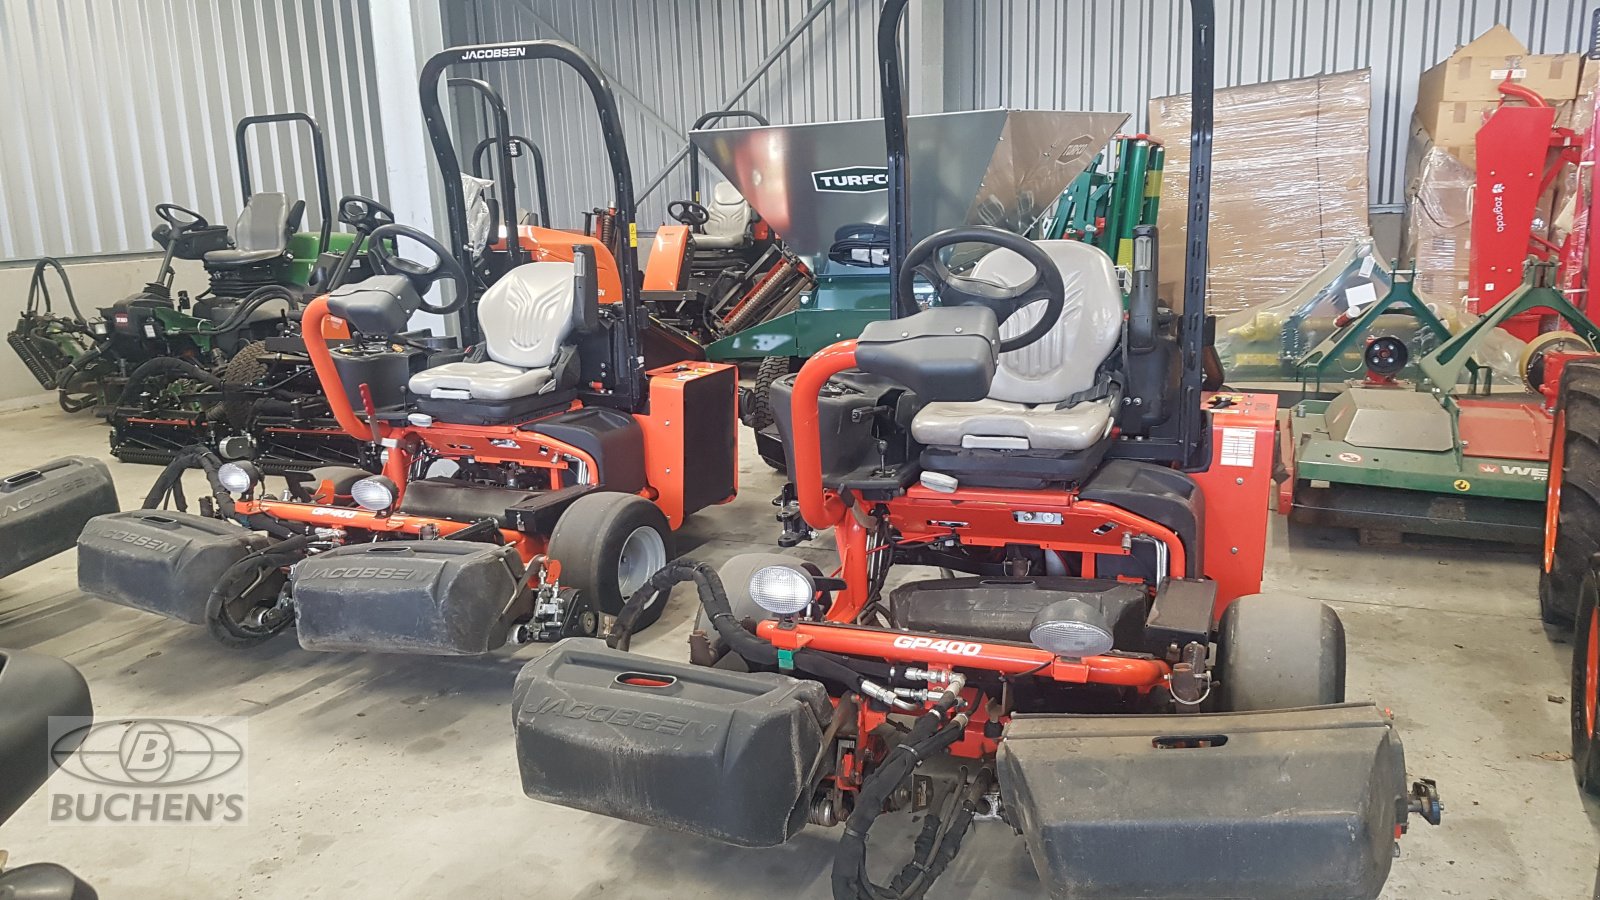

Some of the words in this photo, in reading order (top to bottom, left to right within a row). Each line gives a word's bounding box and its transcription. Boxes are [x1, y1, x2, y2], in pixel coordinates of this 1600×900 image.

[461, 47, 526, 60] JACOBSEN
[820, 174, 888, 187] TURFC
[1493, 196, 1507, 232] zagroda
[312, 507, 358, 519] GP400
[299, 566, 429, 582] JACOBSEN
[893, 636, 983, 656] GP400
[525, 696, 718, 740] JACOBSEN
